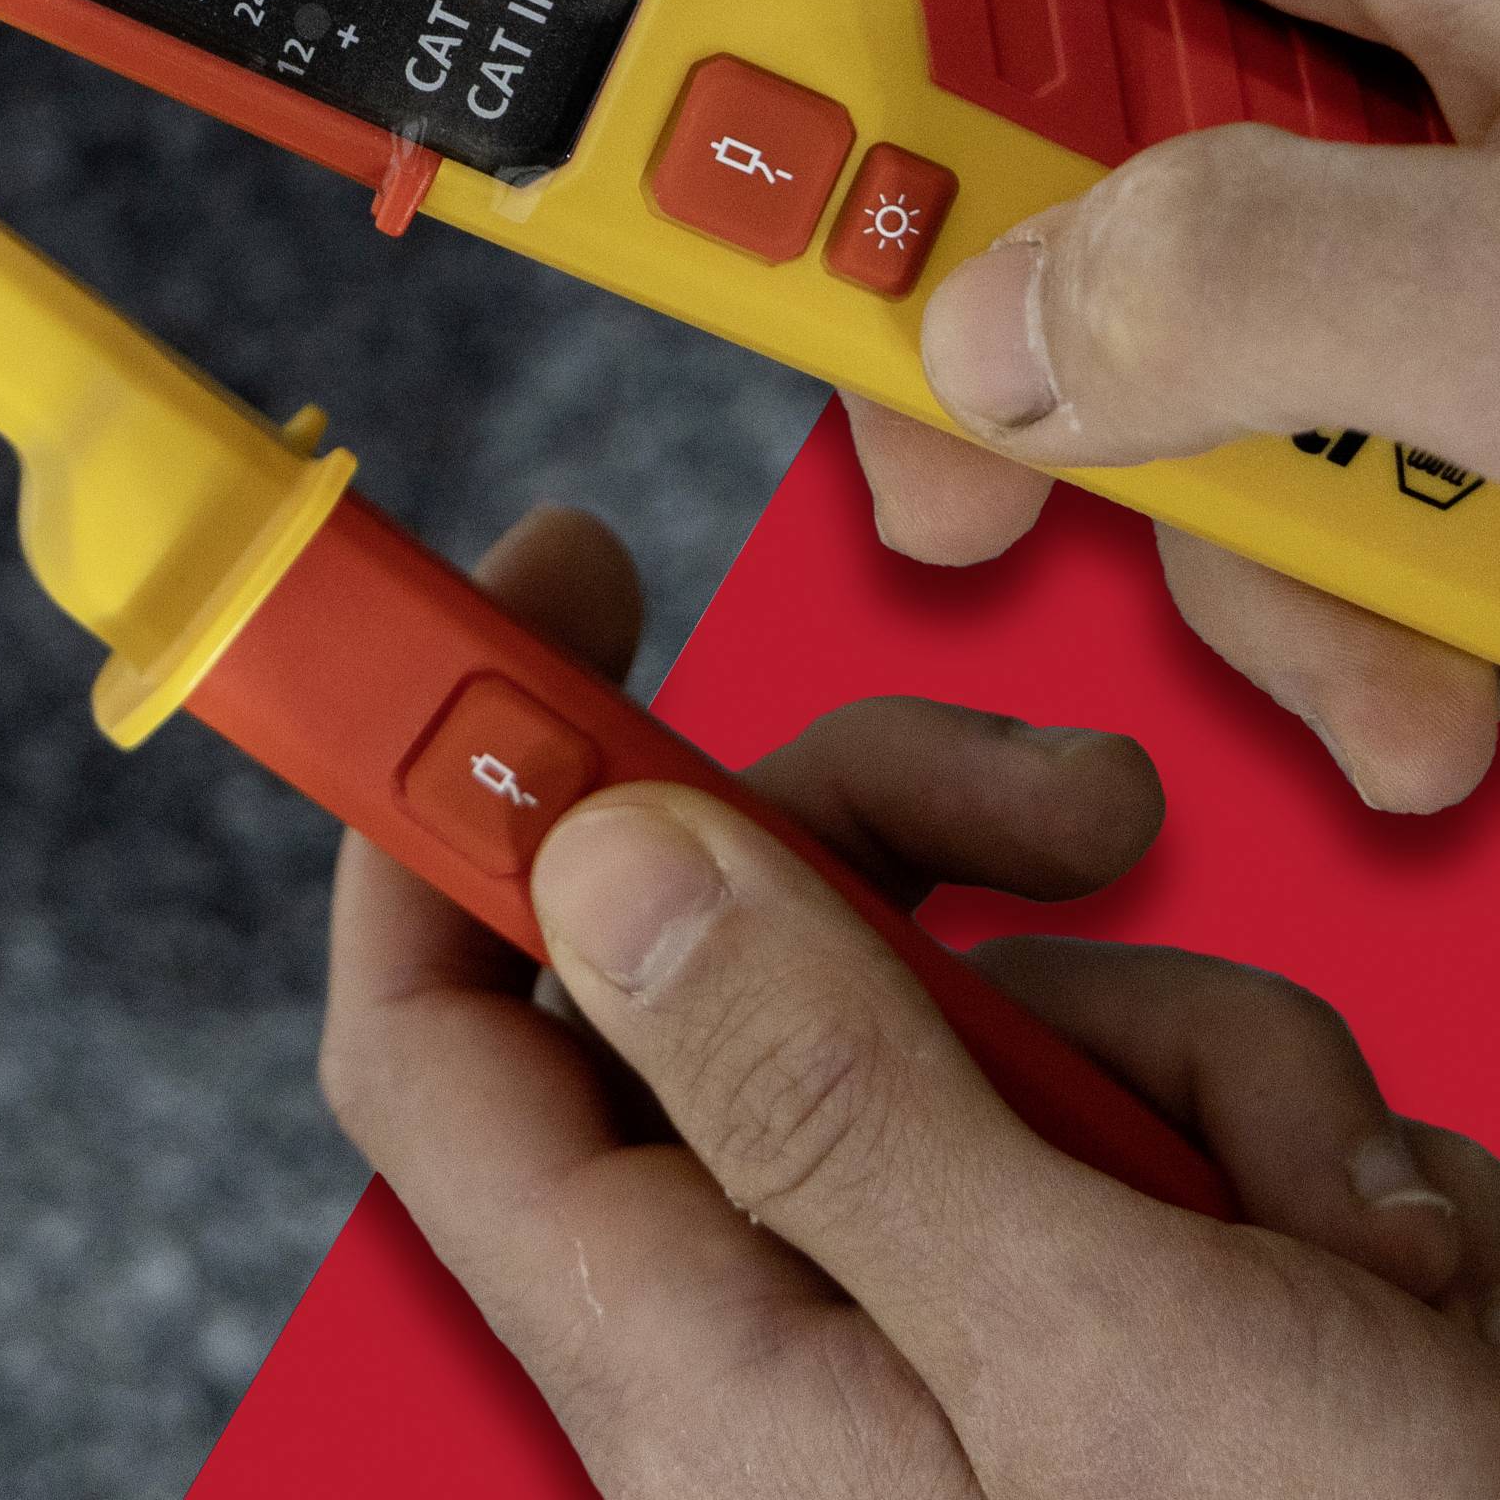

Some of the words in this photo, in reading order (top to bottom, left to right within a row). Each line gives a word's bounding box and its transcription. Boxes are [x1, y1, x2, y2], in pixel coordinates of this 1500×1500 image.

[277, 38, 315, 76] 12
[405, 0, 469, 92] CAT
[467, 27, 532, 120] CAT
